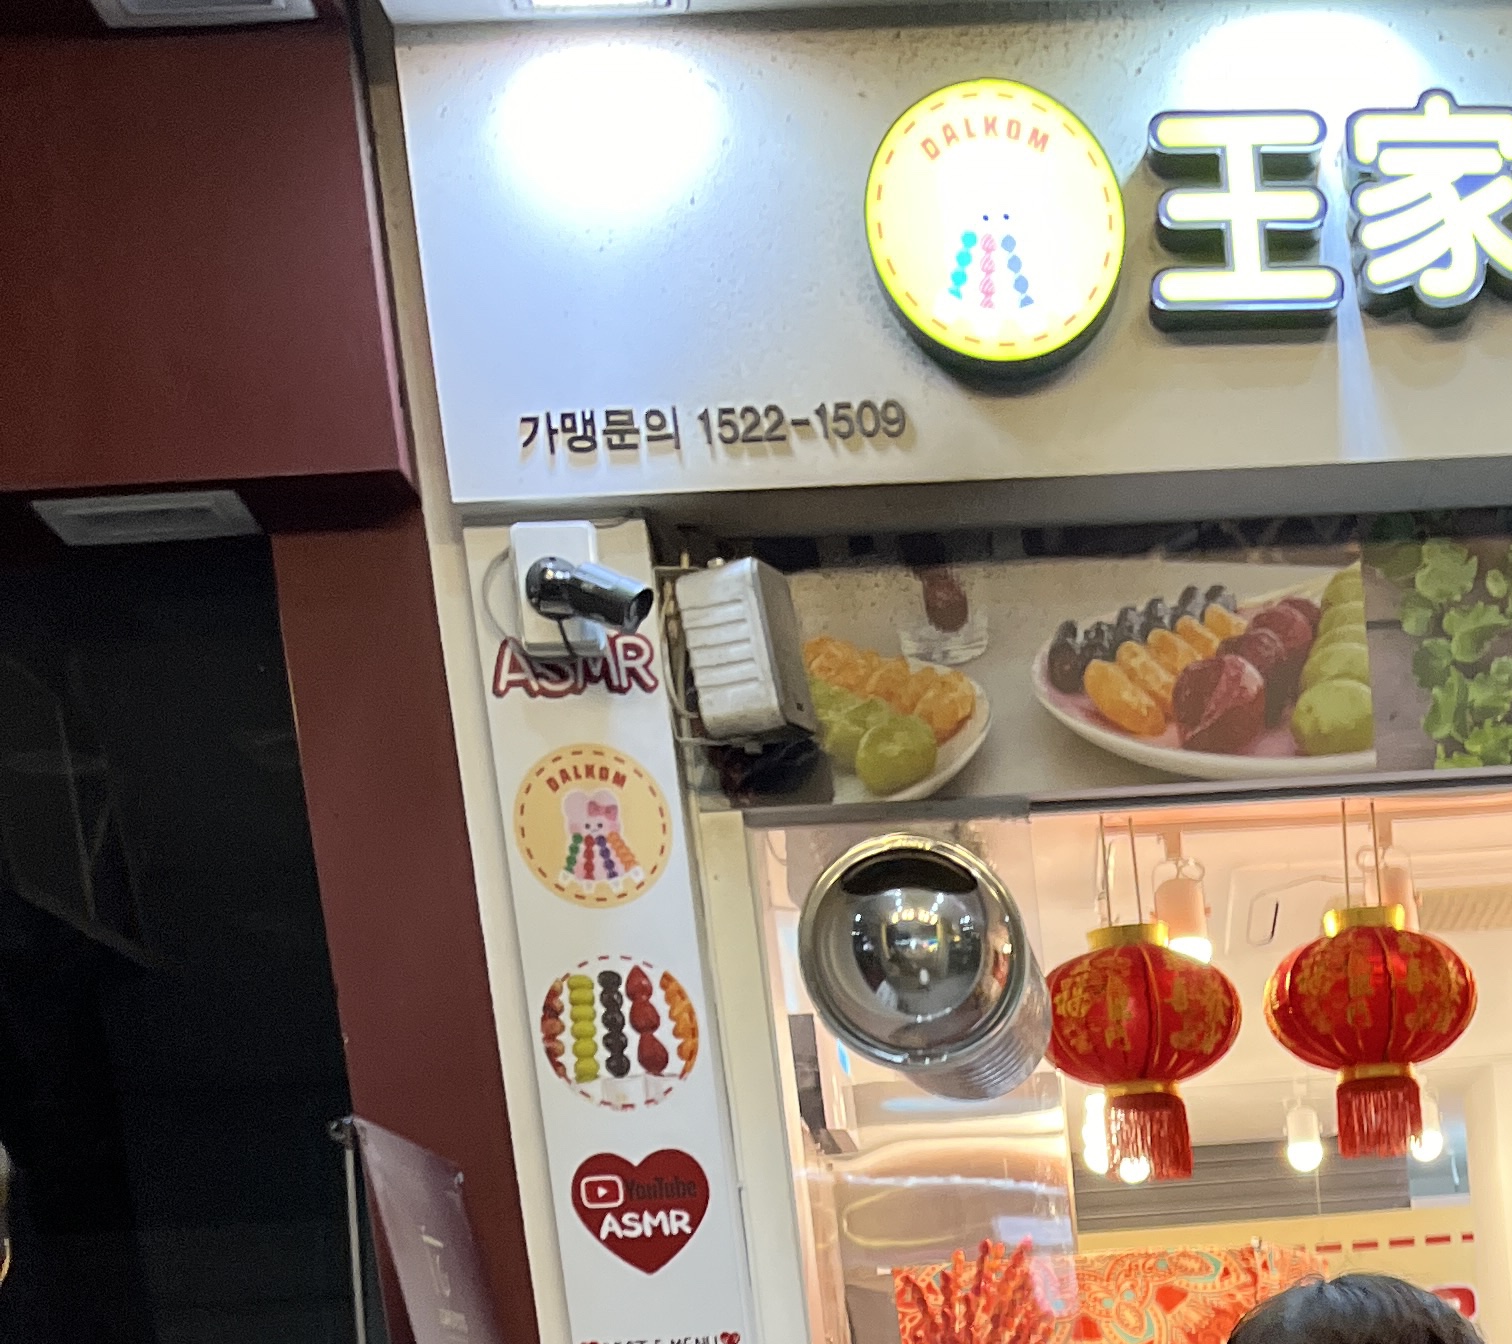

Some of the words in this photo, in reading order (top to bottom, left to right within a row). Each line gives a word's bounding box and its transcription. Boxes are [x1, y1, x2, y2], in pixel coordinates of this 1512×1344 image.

[920, 116, 1050, 162] DALKOM
[519, 404, 682, 455] 가맹문의
[698, 398, 907, 445] 1522-1509
[546, 764, 628, 793] DALKOM
[625, 1176, 698, 1201] YouTube
[600, 1210, 692, 1240] ASMR
